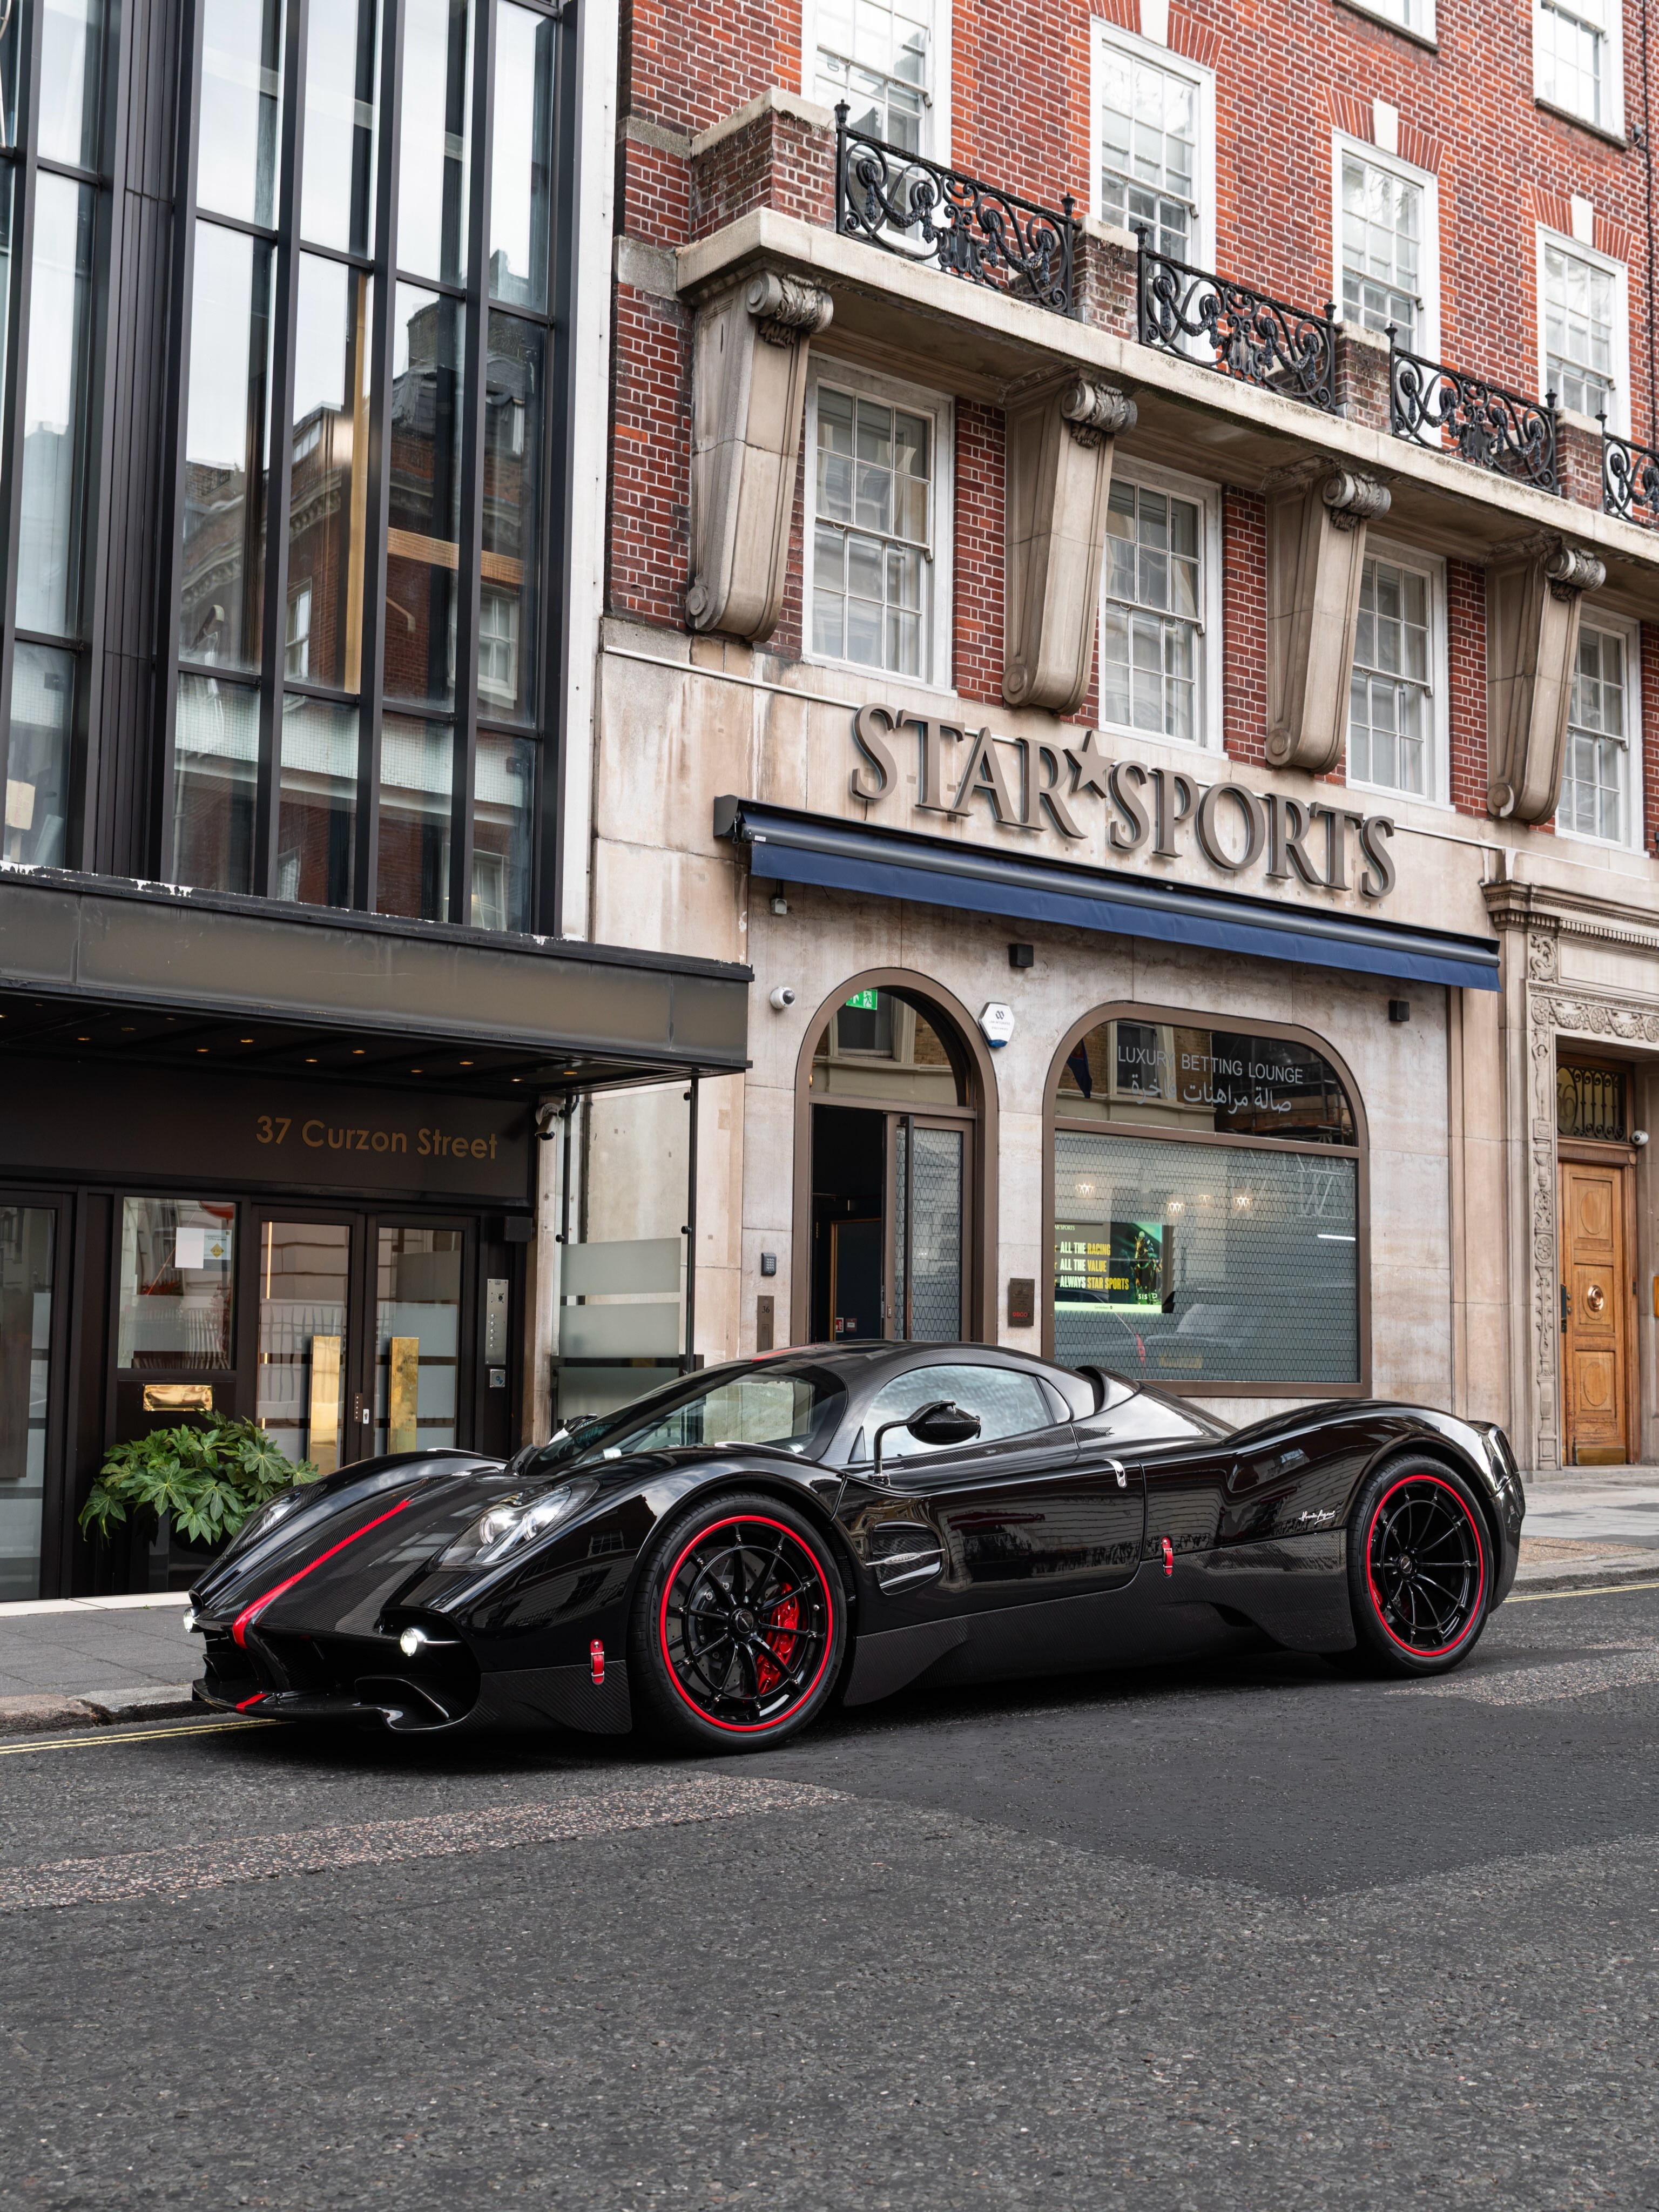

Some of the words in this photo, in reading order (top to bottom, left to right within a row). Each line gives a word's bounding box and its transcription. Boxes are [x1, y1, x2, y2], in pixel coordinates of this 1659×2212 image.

[851, 703, 1088, 840] STAR
[1109, 759, 1397, 899] SPORTS
[1117, 1045, 1175, 1068] LUXURY
[1181, 1054, 1243, 1077] BETTING
[1248, 1062, 1303, 1084] LOUNGE
[1131, 1073, 1177, 1104] فاخرة
[1183, 1081, 1249, 1114] مراهنات
[1255, 1085, 1292, 1114] صالة
[256, 1115, 292, 1144] 37
[301, 1120, 407, 1154] Curzon
[416, 1128, 498, 1159] Street
[1060, 1241, 1073, 1253] ALL
[1073, 1242, 1086, 1255] THE
[1087, 1243, 1111, 1256] RACING
[1060, 1258, 1073, 1271] ALL
[1073, 1259, 1086, 1271] THE
[1087, 1259, 1107, 1272] VALUE
[1060, 1275, 1086, 1288] ALWAYS
[1087, 1277, 1104, 1289] STAR
[1105, 1277, 1129, 1290] SPORTS
